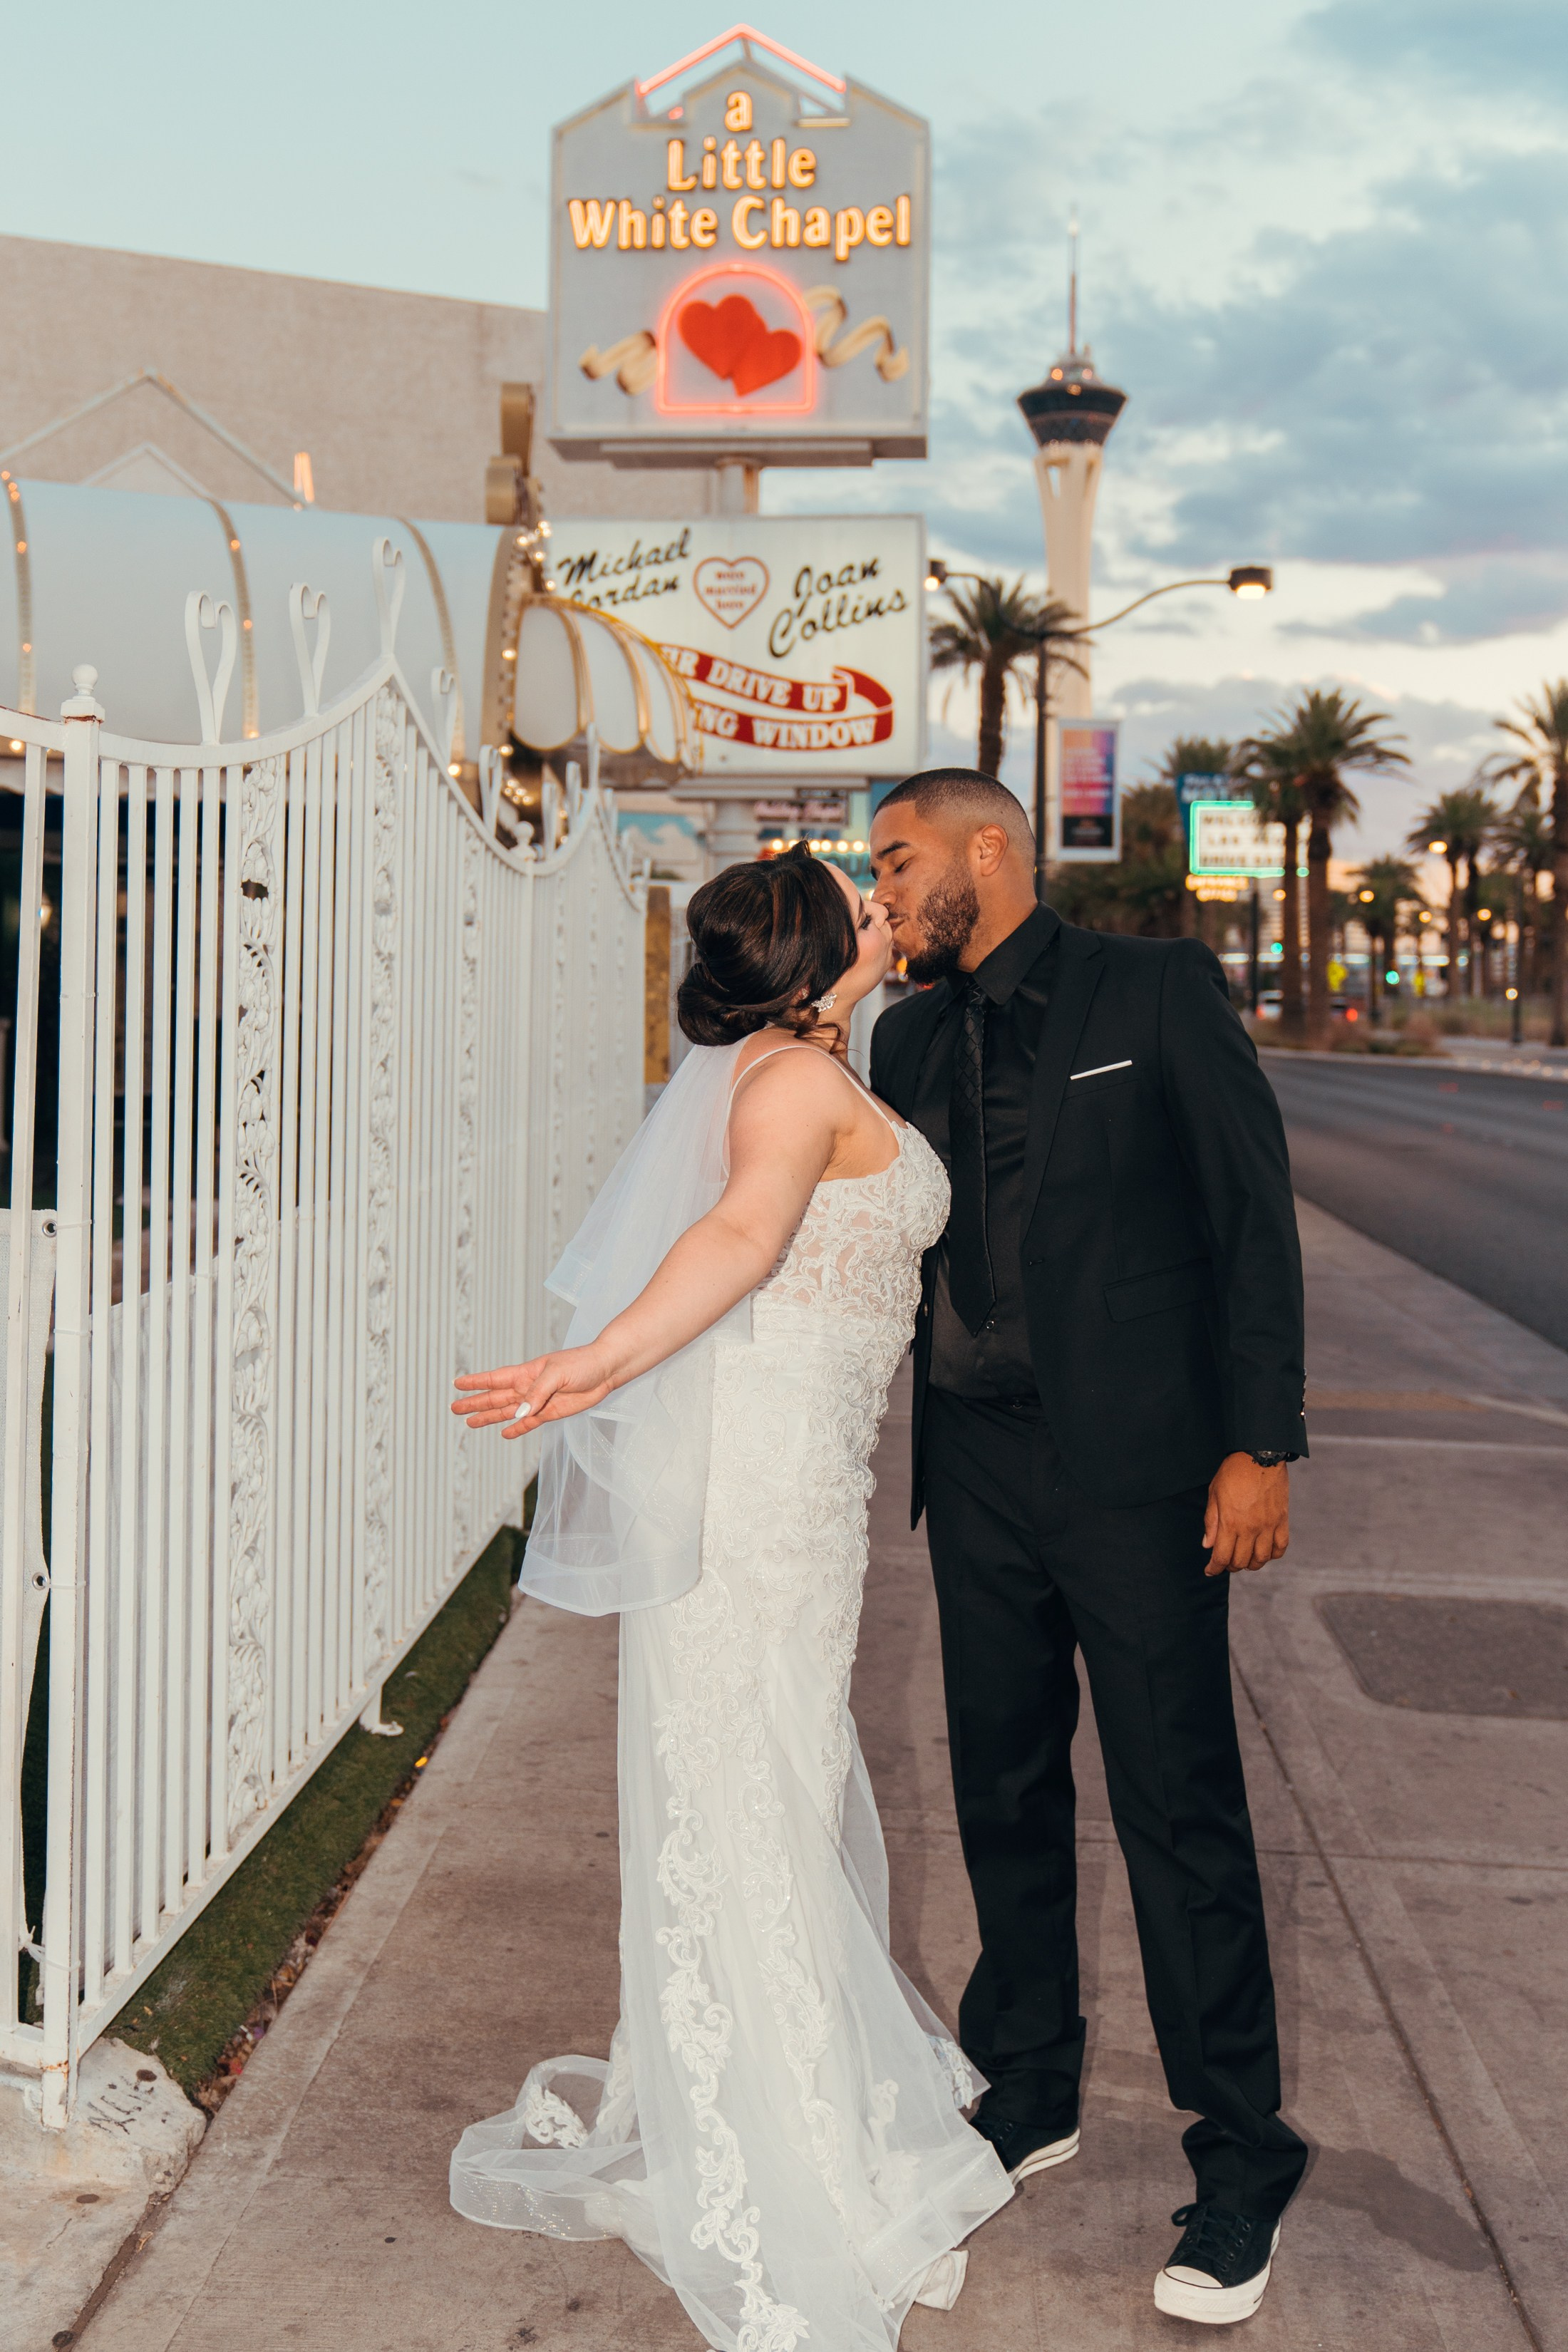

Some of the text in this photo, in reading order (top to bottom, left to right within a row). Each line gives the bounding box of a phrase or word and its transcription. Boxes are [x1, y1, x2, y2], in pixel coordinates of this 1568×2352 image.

[724, 91, 753, 132] a
[666, 135, 817, 191] Little
[568, 195, 911, 262] White Chapel
[557, 527, 691, 587] Michael
[793, 556, 882, 618] Joan
[768, 589, 909, 659] Collins
[707, 659, 793, 706] DRIVE
[802, 684, 842, 712] UP
[752, 716, 877, 748] WINDOW
